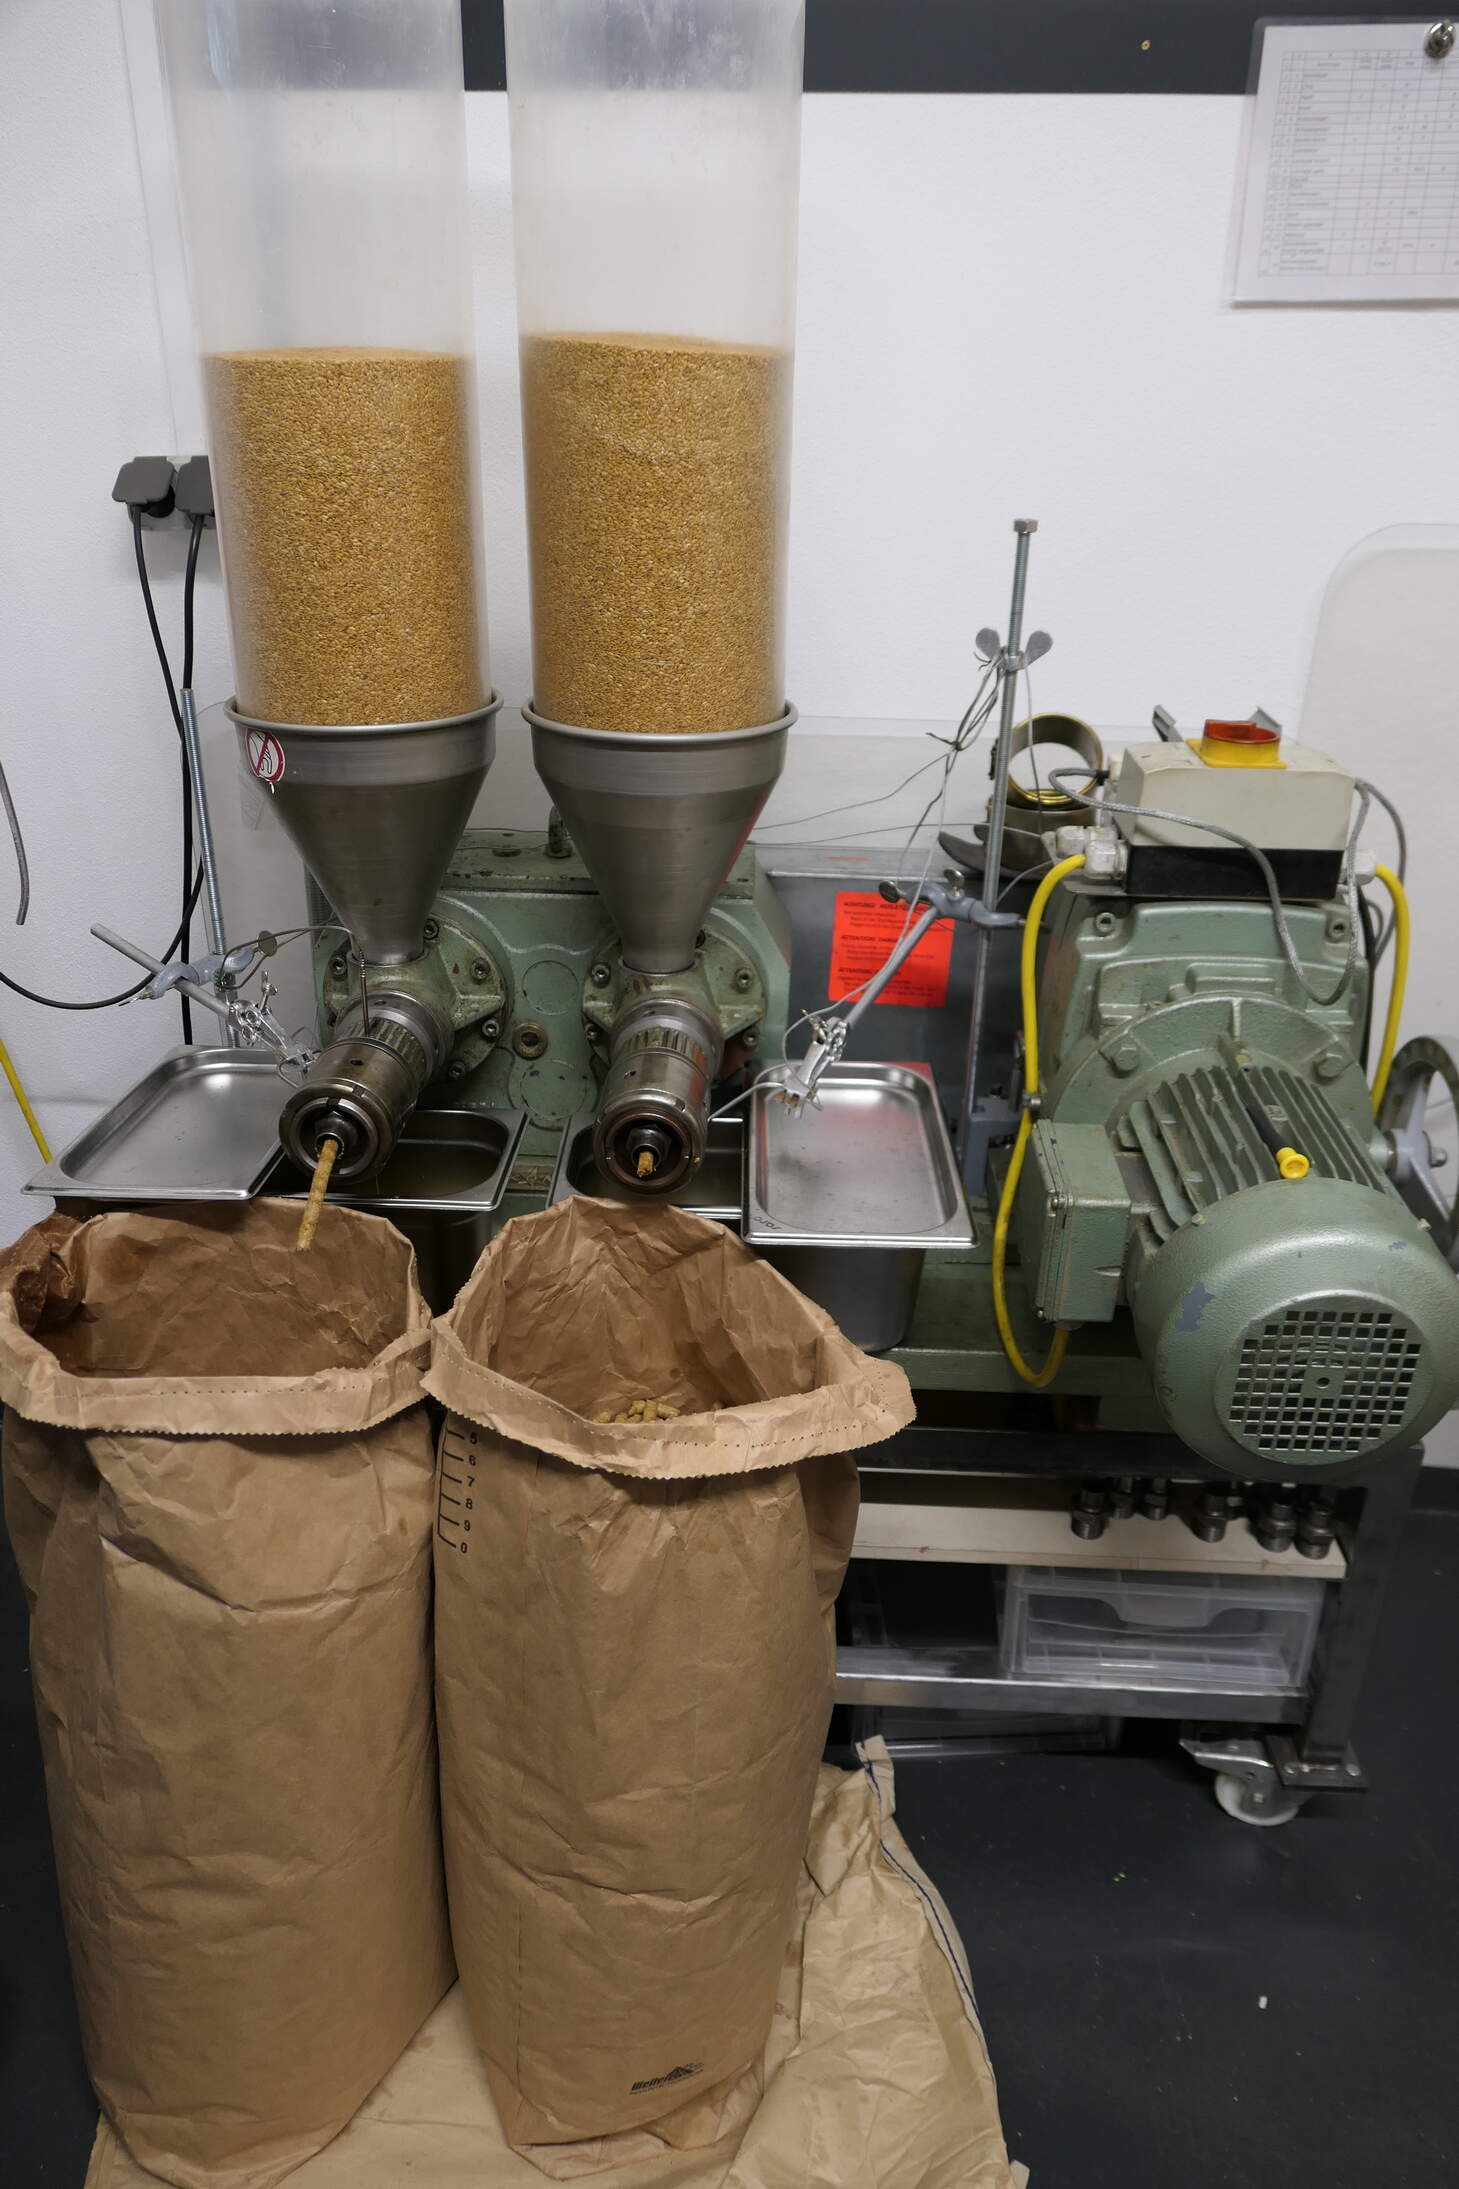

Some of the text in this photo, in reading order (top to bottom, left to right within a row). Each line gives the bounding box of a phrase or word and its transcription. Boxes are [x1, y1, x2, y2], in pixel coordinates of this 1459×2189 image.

[470, 1432, 477, 1444] 5
[469, 1455, 476, 1467] 6
[467, 1476, 475, 1487] 7
[466, 1498, 473, 1510] 8
[464, 1520, 471, 1532] 9
[461, 1542, 468, 1554] 0
